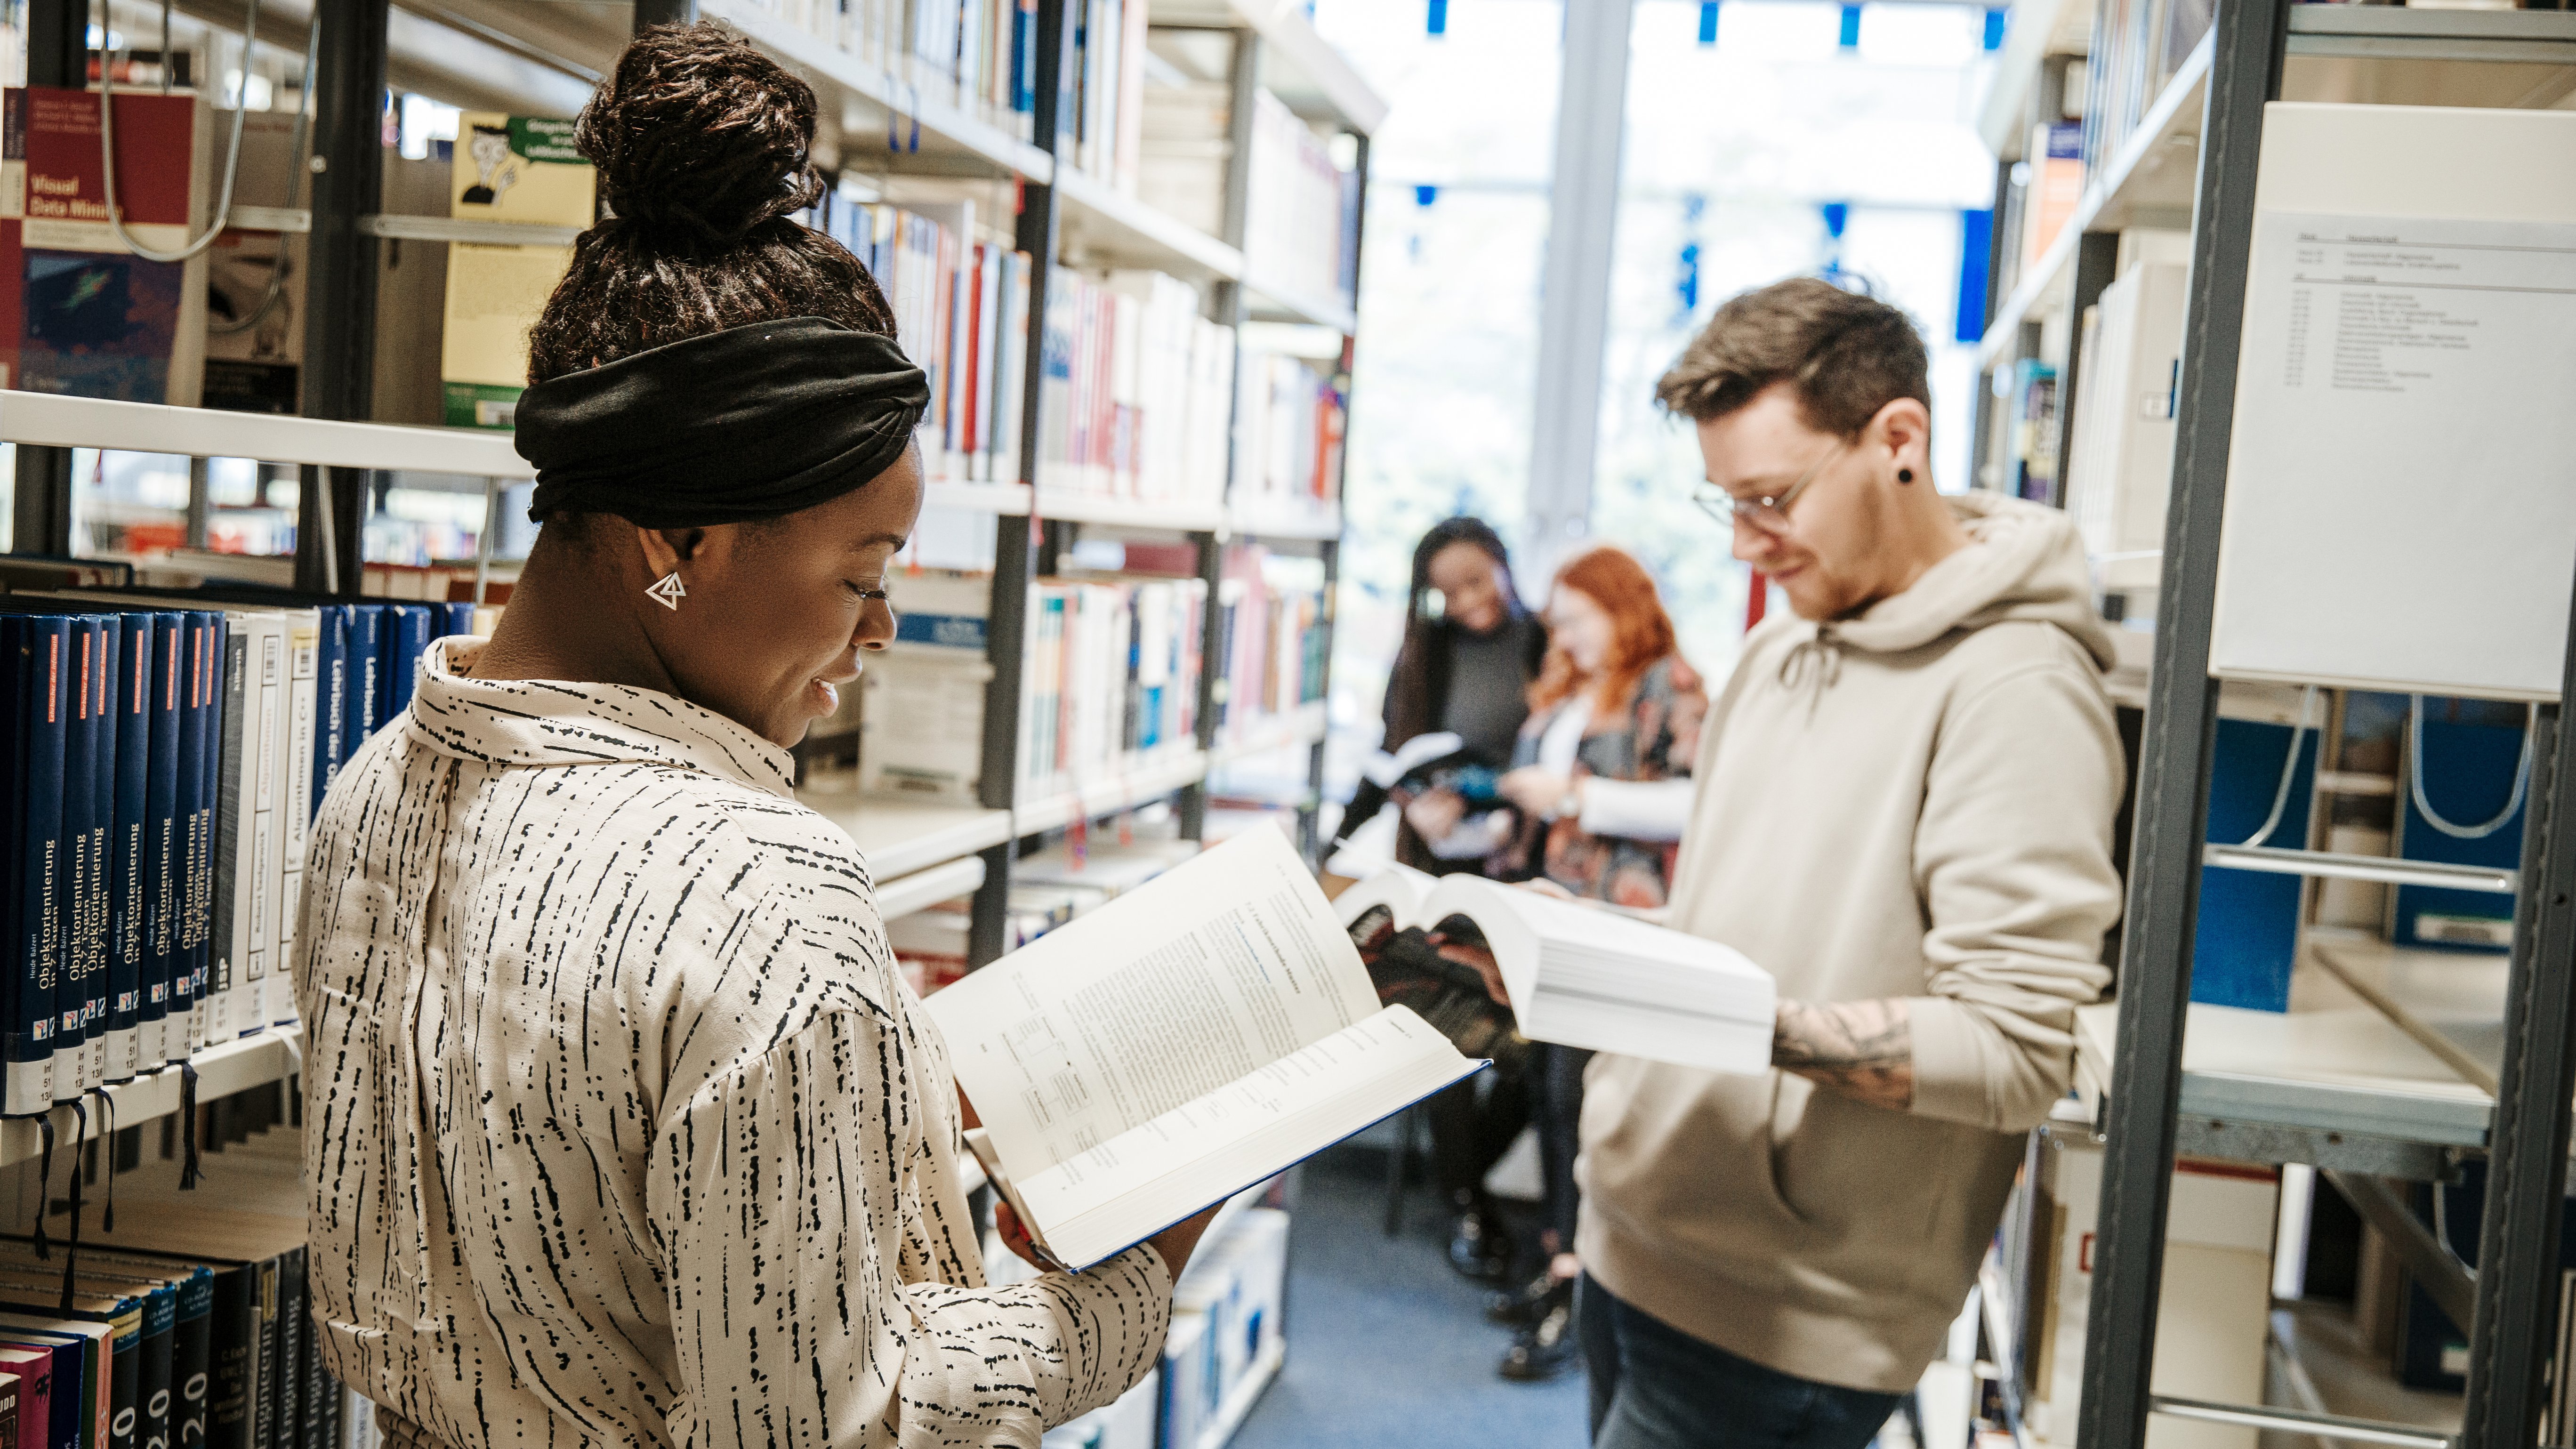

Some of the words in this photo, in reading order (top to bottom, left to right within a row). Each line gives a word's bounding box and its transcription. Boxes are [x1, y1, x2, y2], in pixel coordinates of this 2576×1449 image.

[30, 173, 79, 195] Visual
[30, 195, 68, 217] Data
[330, 659, 343, 730] Lehrbuch
[363, 657, 376, 727] Lehrbuch
[298, 726, 307, 741] in
[328, 733, 339, 758] der
[362, 729, 372, 742] d
[323, 763, 338, 790] Obj
[292, 746, 306, 842] Algorithmen
[124, 823, 139, 964] Objektorientierung
[157, 817, 171, 956] Objektorientierung
[182, 813, 198, 950] Objektorientierung
[70, 834, 86, 981] Objektorientierung
[88, 828, 104, 971] Objektorientierung
[99, 891, 108, 936] Tagen
[40, 840, 55, 989] Objektorientierung
[81, 899, 89, 944] Tagen
[80, 950, 87, 959] 7
[98, 942, 106, 950] 7
[134, 948, 140, 962] in
[1250, 912, 1304, 995] Fabrikmethode-Muster
[49, 958, 56, 967] 7
[81, 964, 87, 979] in
[98, 955, 105, 969] in
[218, 958, 229, 989] JSP
[49, 972, 56, 987] in
[95, 1056, 102, 1065] 51
[129, 1046, 135, 1056] 51
[44, 1078, 50, 1087] 51
[78, 1064, 83, 1074] 51
[280, 1295, 302, 1441] Engineering
[257, 1321, 274, 1449] Engineerin
[182, 1372, 208, 1444] 2.0
[112, 1407, 136, 1449] .0
